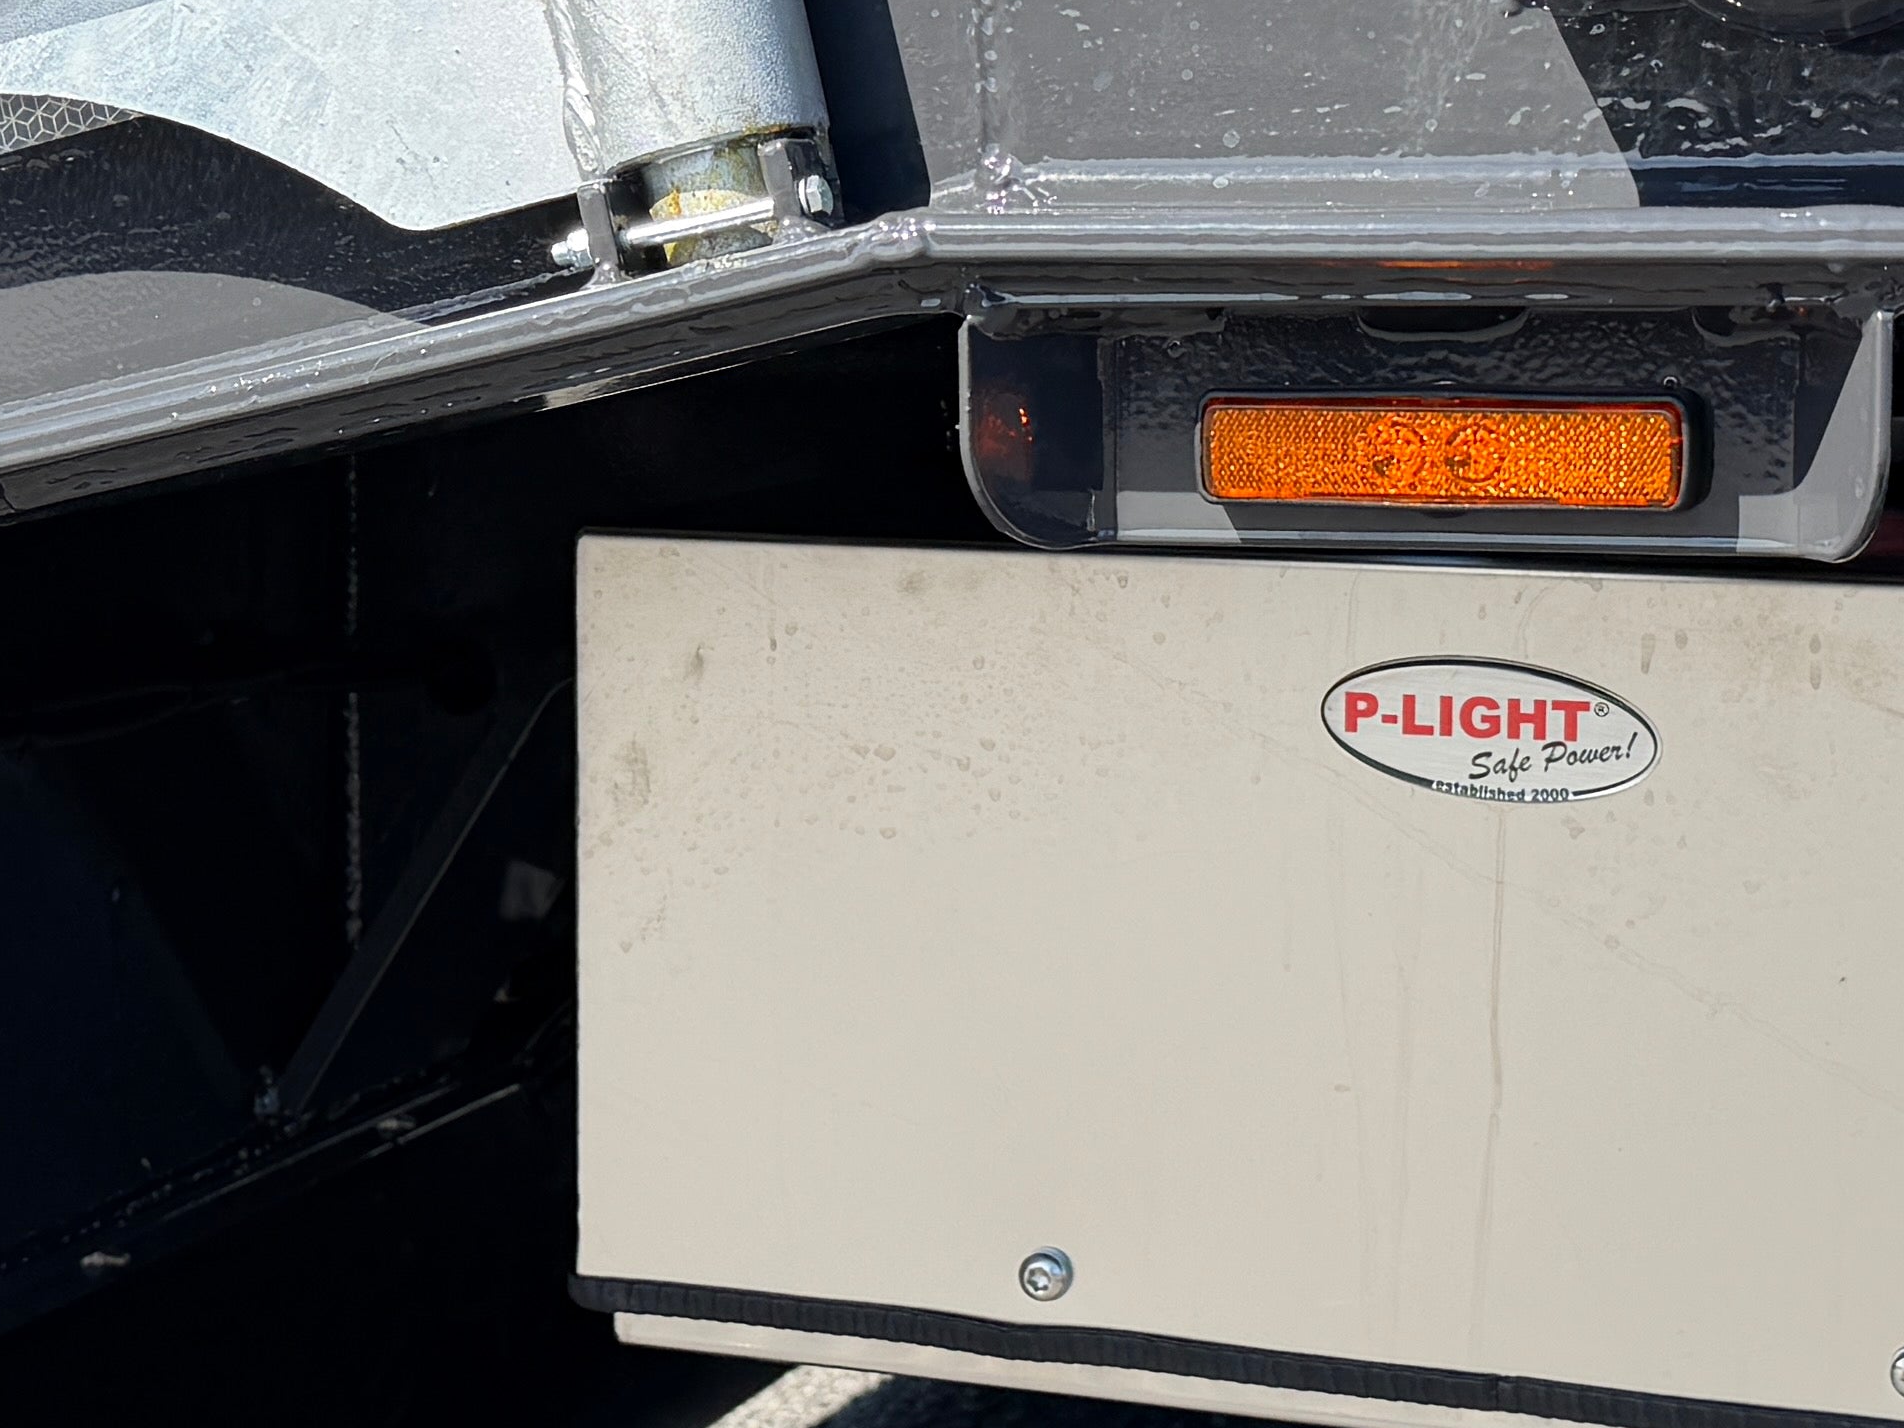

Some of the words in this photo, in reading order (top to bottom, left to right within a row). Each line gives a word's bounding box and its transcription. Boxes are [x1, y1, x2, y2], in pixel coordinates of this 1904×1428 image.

[1467, 747, 1533, 783] Safe
[1540, 731, 1639, 773] Power!
[1435, 779, 1526, 802] established
[1530, 787, 1570, 803] 2000
